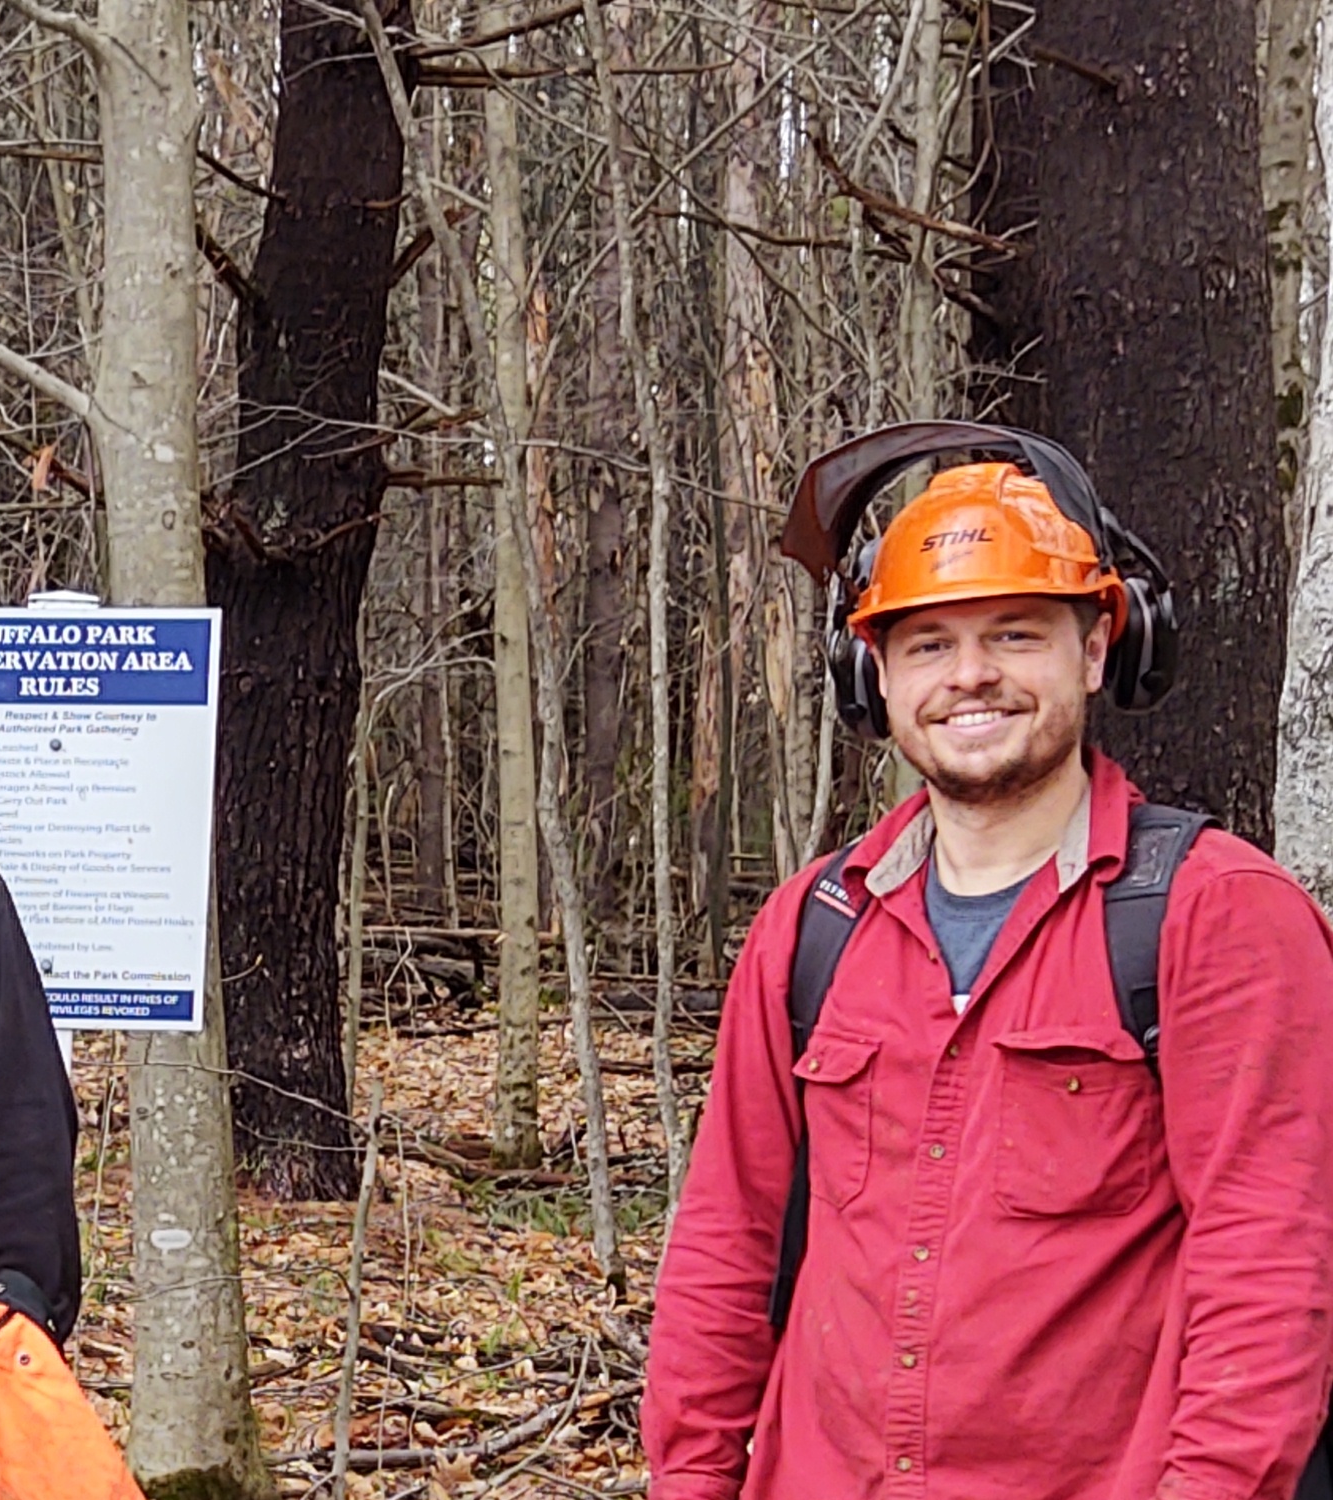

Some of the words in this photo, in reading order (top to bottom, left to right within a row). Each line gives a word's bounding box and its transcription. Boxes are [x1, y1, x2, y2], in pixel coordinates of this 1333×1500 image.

[920, 528, 993, 552] STIHL
[85, 625, 155, 645] PARK
[122, 651, 193, 671] AREA
[19, 677, 100, 696] RULES
[5, 710, 48, 721] Respect
[51, 711, 59, 720] &
[62, 711, 91, 720] Show
[95, 711, 143, 722] Courtesy
[146, 712, 157, 721] to
[58, 724, 82, 733] Park
[86, 724, 139, 736] Gathering
[73, 970, 91, 980] the
[94, 970, 118, 980] Park
[121, 970, 191, 982] Commission
[82, 993, 119, 1003] RESULT
[120, 993, 132, 1004] IN
[133, 993, 162, 1005] FINES
[49, 1004, 100, 1016] RIVILEGES
